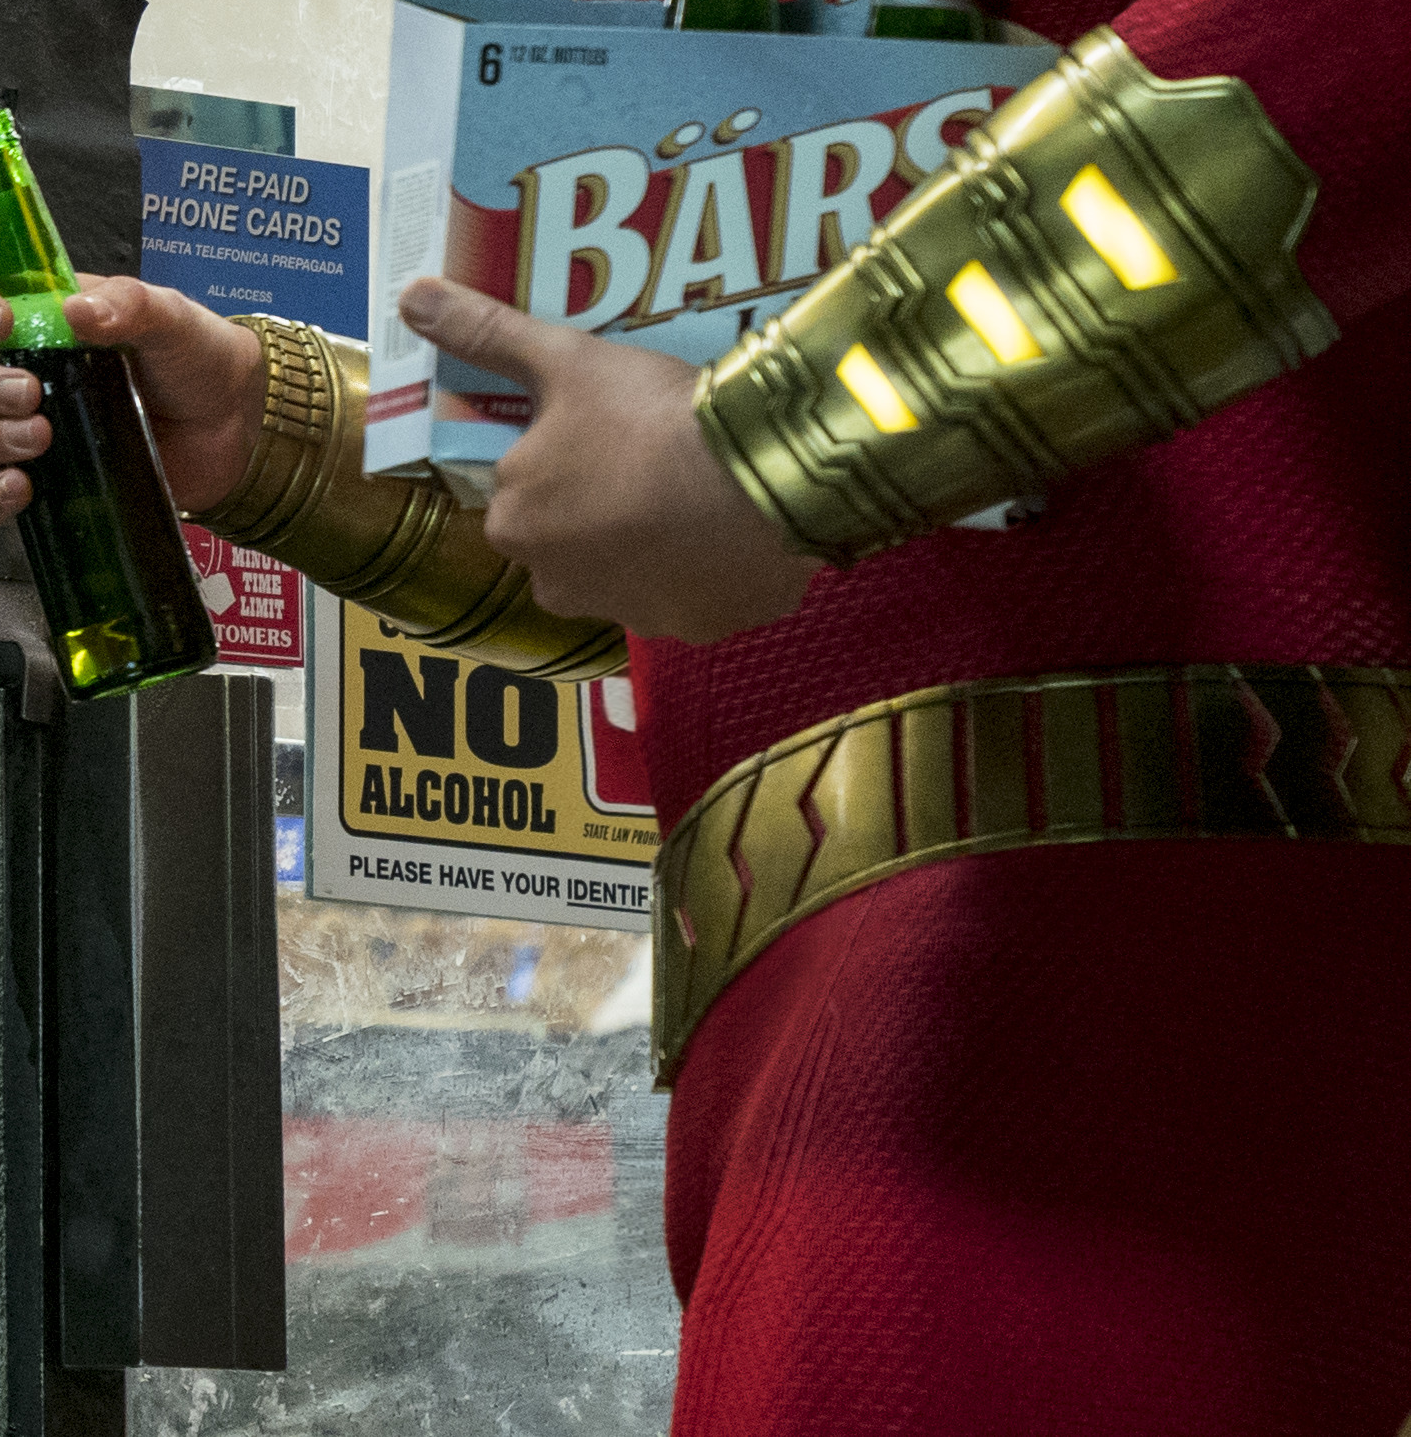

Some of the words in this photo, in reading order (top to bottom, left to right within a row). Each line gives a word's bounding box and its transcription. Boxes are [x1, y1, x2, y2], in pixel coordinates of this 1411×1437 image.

[479, 43, 503, 86] 6
[180, 161, 310, 204] PRE-PAID
[142, 193, 240, 232] PHONE
[246, 207, 342, 246] CARDS
[141, 237, 192, 256] TARJETA
[195, 244, 269, 266] TELEFONICA
[272, 254, 344, 276] PREPAGADA
[207, 285, 227, 298] ALL
[229, 287, 273, 303] ACCESS
[242, 571, 282, 595] TIME
[240, 596, 285, 620] LIMIT
[214, 623, 293, 648] TOMERS
[359, 647, 559, 769] NO
[360, 763, 556, 834] ALCOHOL
[583, 823, 610, 841] STATE
[611, 826, 631, 843] LAW
[631, 829, 662, 846] PROHI
[349, 854, 433, 885] PLEASE
[439, 864, 495, 892] HAVE
[501, 871, 561, 898] YOUR
[567, 878, 649, 907] IDENTIF
